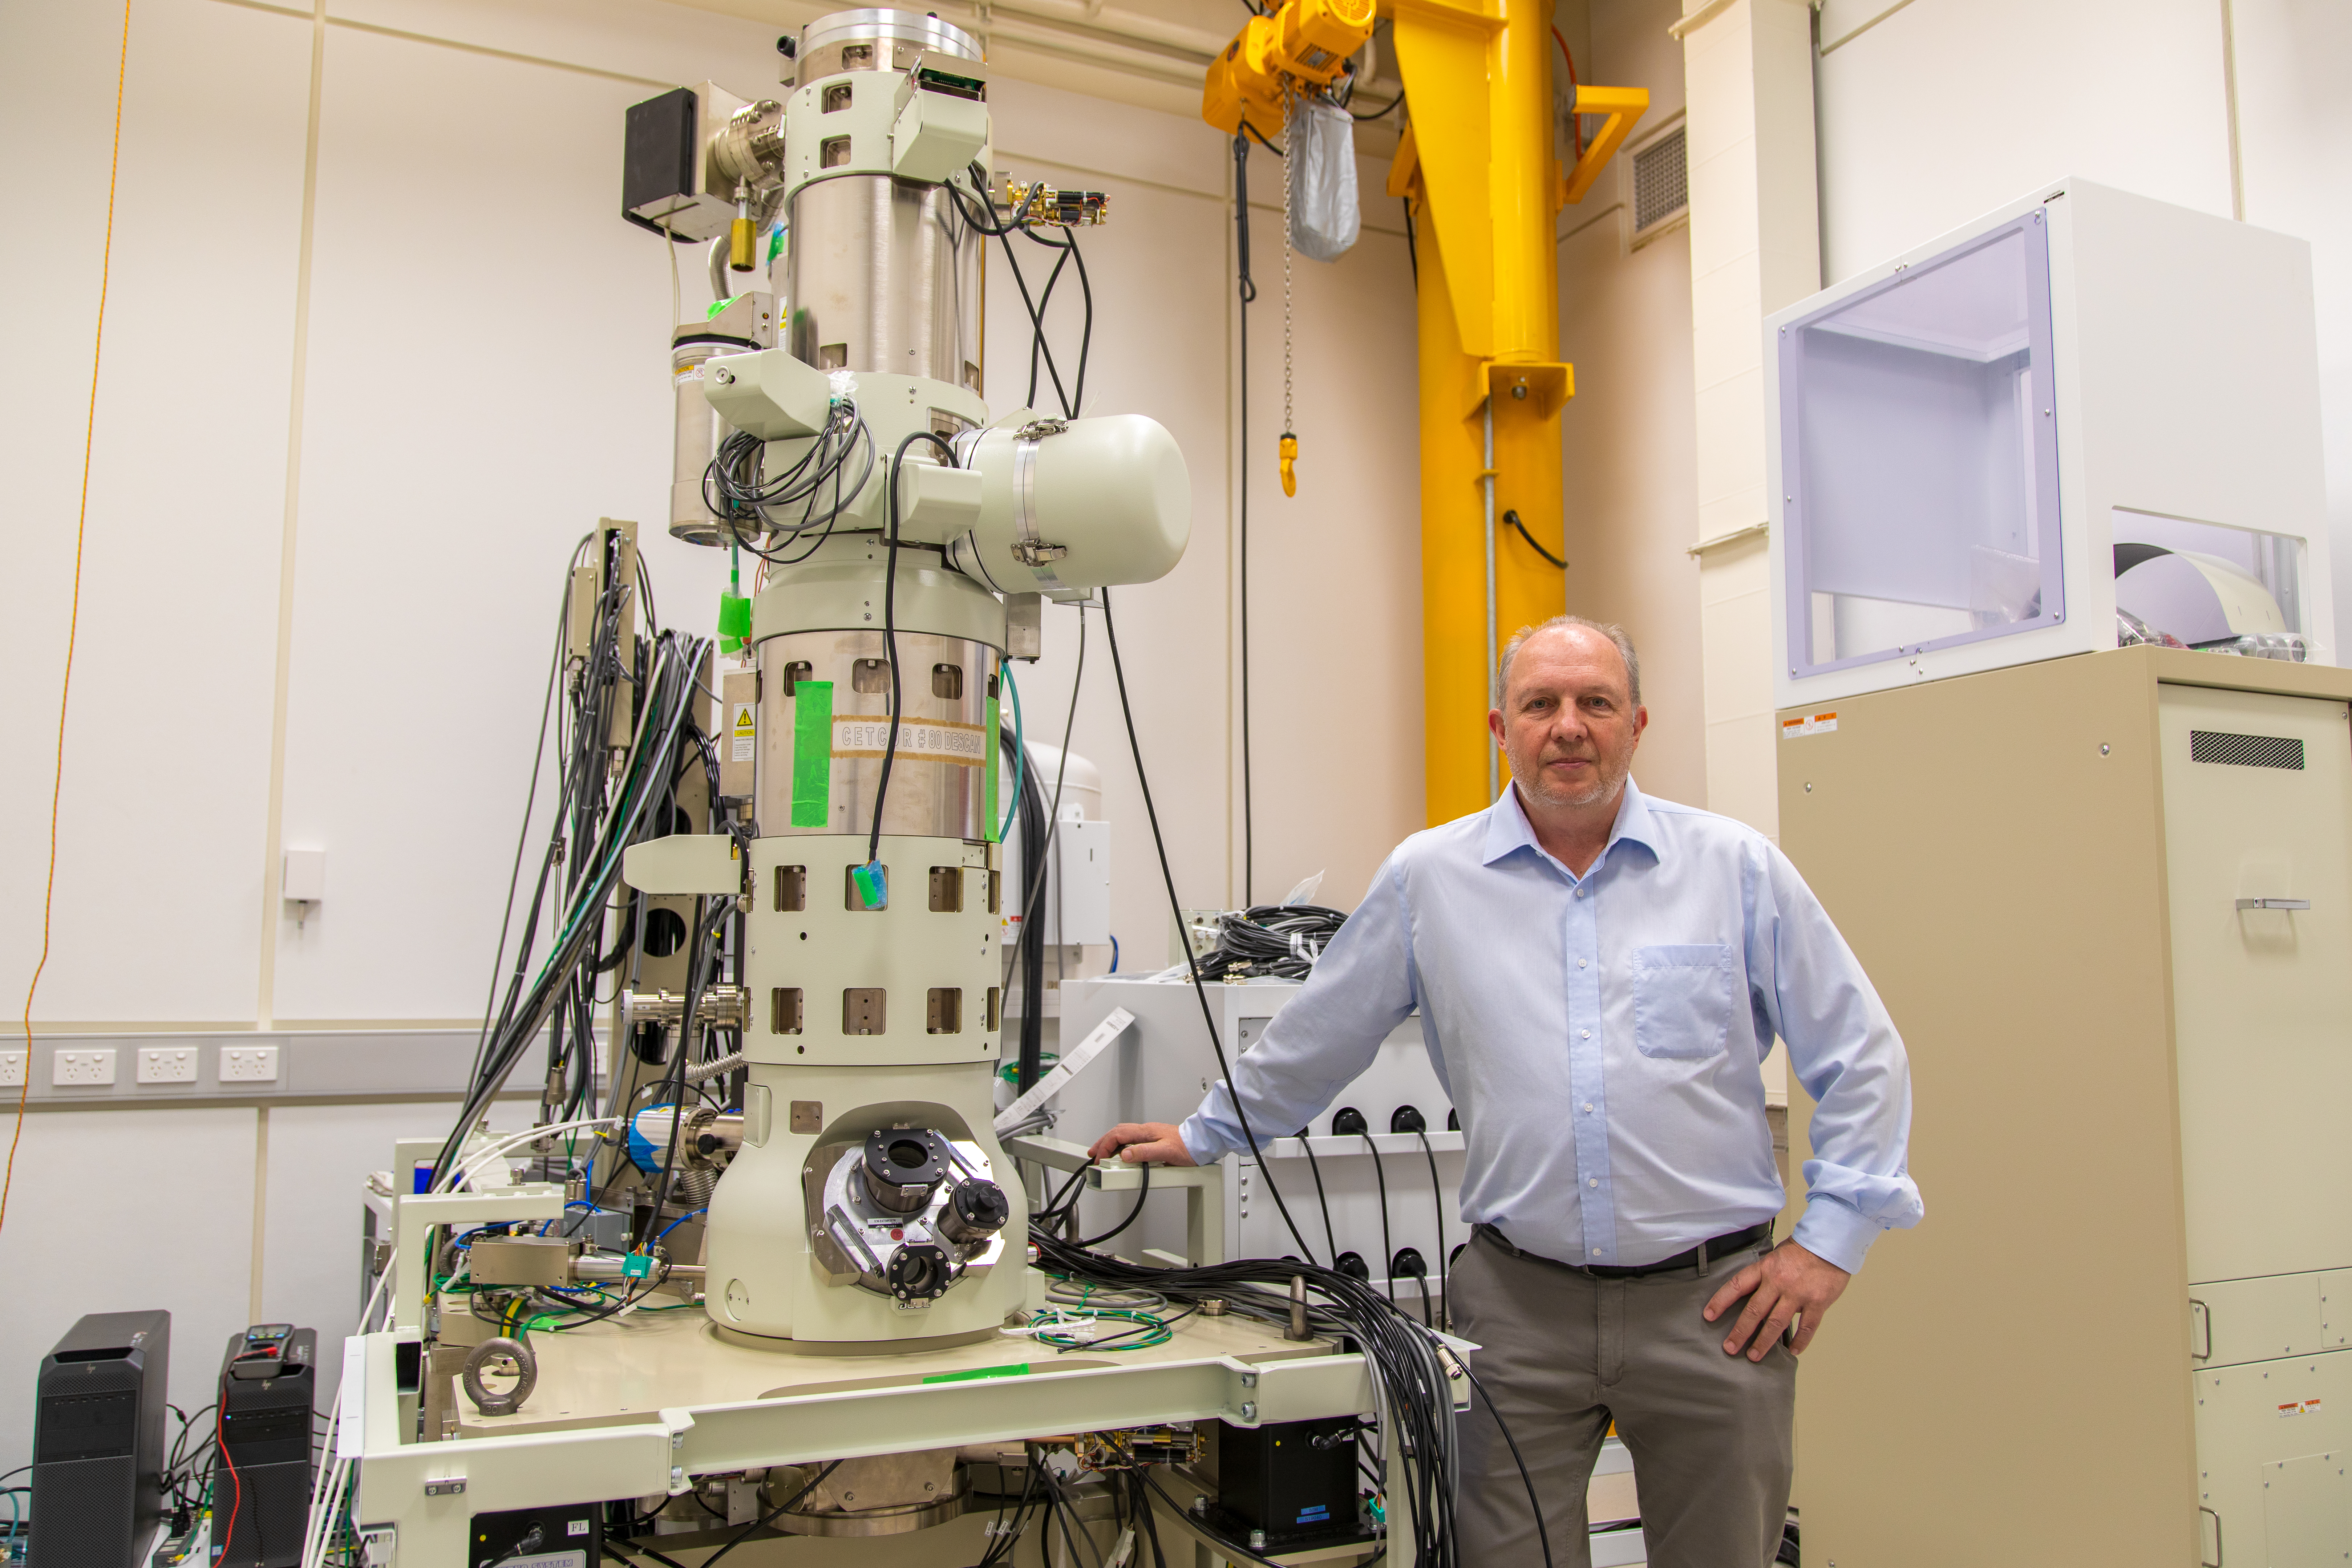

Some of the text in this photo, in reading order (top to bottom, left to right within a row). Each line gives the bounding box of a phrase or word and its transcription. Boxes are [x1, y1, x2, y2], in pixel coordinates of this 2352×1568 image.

[918, 729, 926, 748] #
[928, 730, 942, 749] 80
[945, 732, 980, 754] DESCAN
[571, 1523, 585, 1531] FL
